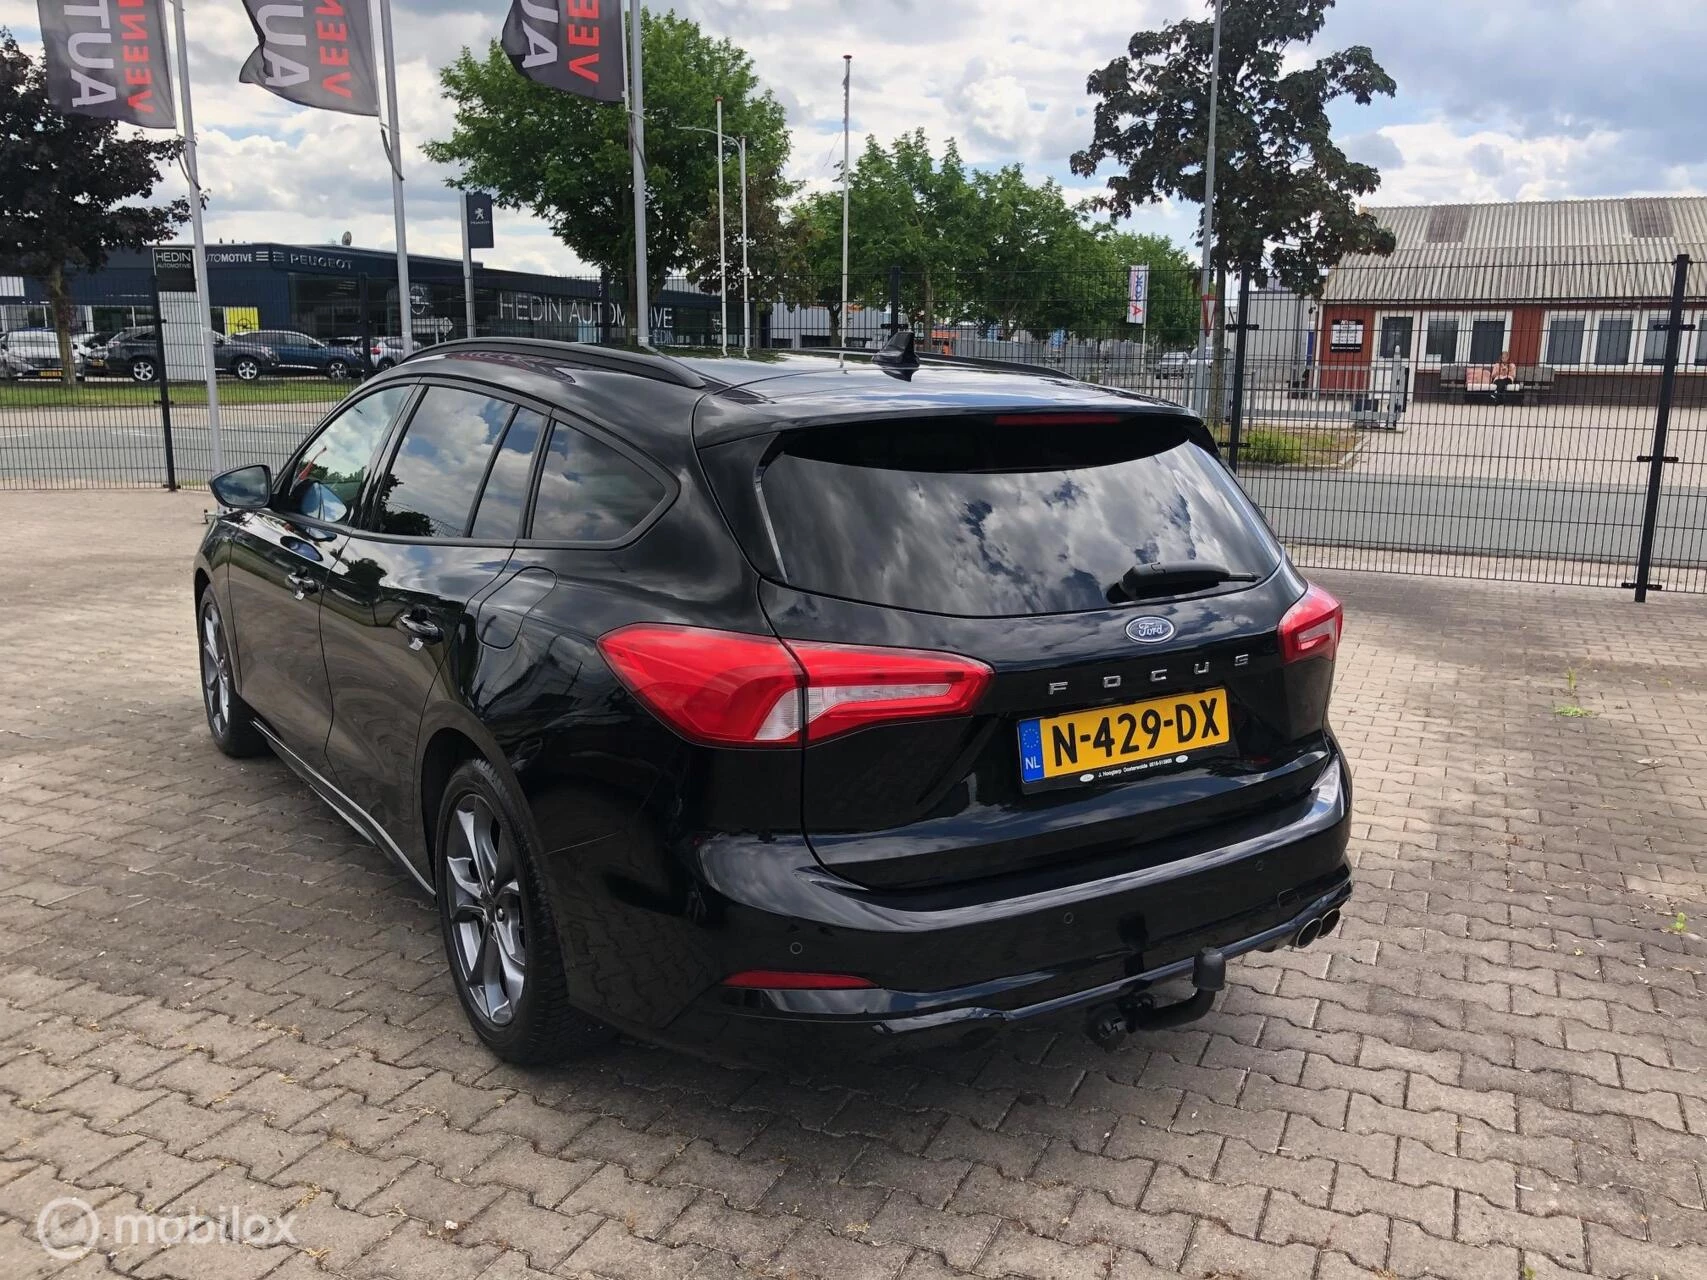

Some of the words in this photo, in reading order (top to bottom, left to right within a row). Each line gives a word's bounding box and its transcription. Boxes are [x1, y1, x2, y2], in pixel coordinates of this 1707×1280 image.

[155, 252, 191, 262] HEDIN
[205, 253, 252, 263] UTOMOTIVE
[290, 253, 353, 269] PEUGEOT
[500, 291, 562, 323] HEDIN
[1138, 622, 1163, 637] Ford
[1049, 653, 1249, 695] FOCUS
[1051, 697, 1220, 767] N-429-DX
[1025, 757, 1041, 770] NL
